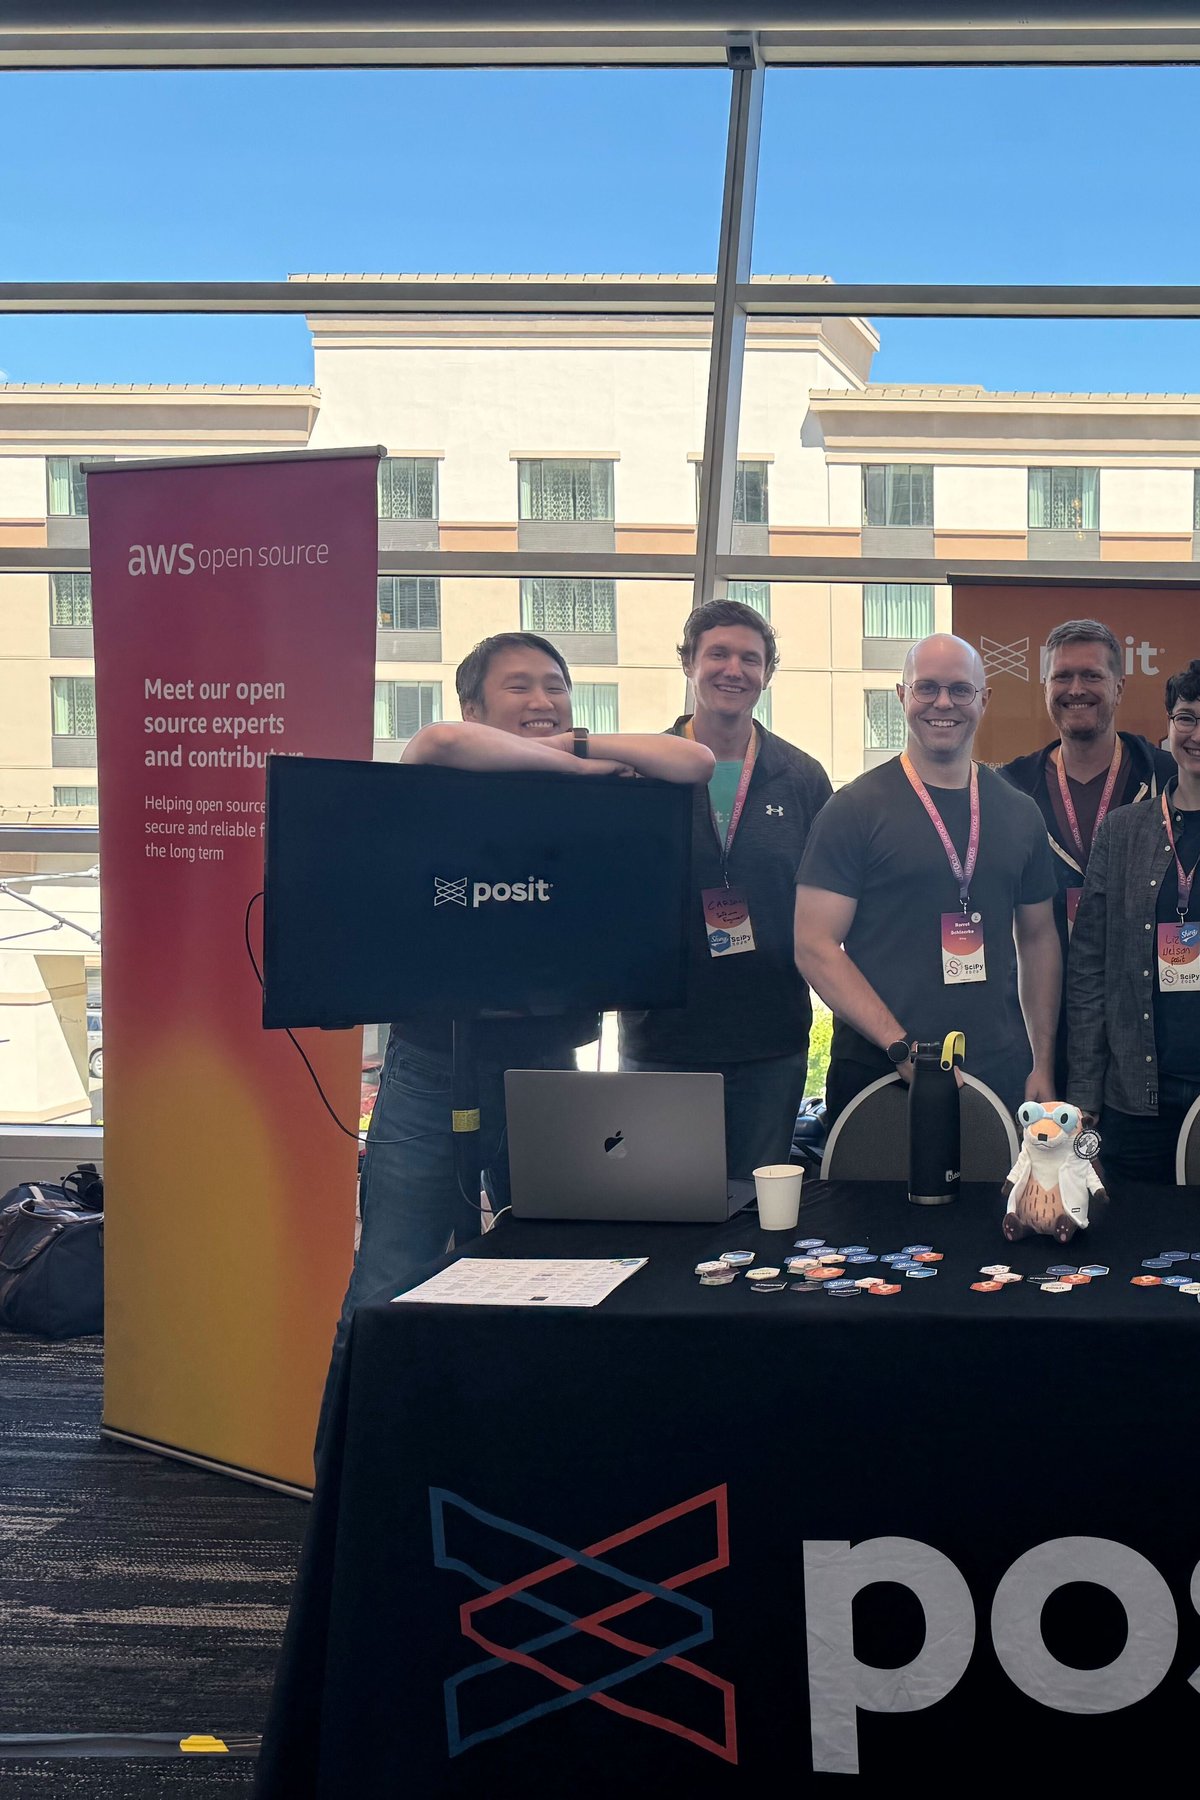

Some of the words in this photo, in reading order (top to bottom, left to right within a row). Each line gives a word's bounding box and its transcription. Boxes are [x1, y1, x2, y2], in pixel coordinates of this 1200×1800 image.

[128, 542, 195, 576] aws
[199, 546, 252, 575] open
[258, 541, 329, 567] source
[144, 678, 194, 700] Meet
[199, 680, 230, 700] our
[236, 680, 285, 705] open
[144, 714, 207, 734] source
[212, 712, 285, 739] experts
[144, 744, 182, 768] and
[188, 745, 304, 768] contribu
[144, 795, 193, 815] Helping
[195, 799, 224, 815] open
[226, 799, 266, 813] source
[144, 822, 185, 836] secure
[188, 820, 208, 836] and
[210, 822, 256, 838] reliable
[144, 843, 167, 859] the
[170, 843, 195, 864] long
[198, 845, 224, 861] term
[473, 876, 550, 908] posit
[964, 963, 984, 971] SciPy
[1180, 973, 1200, 981] SciPy
